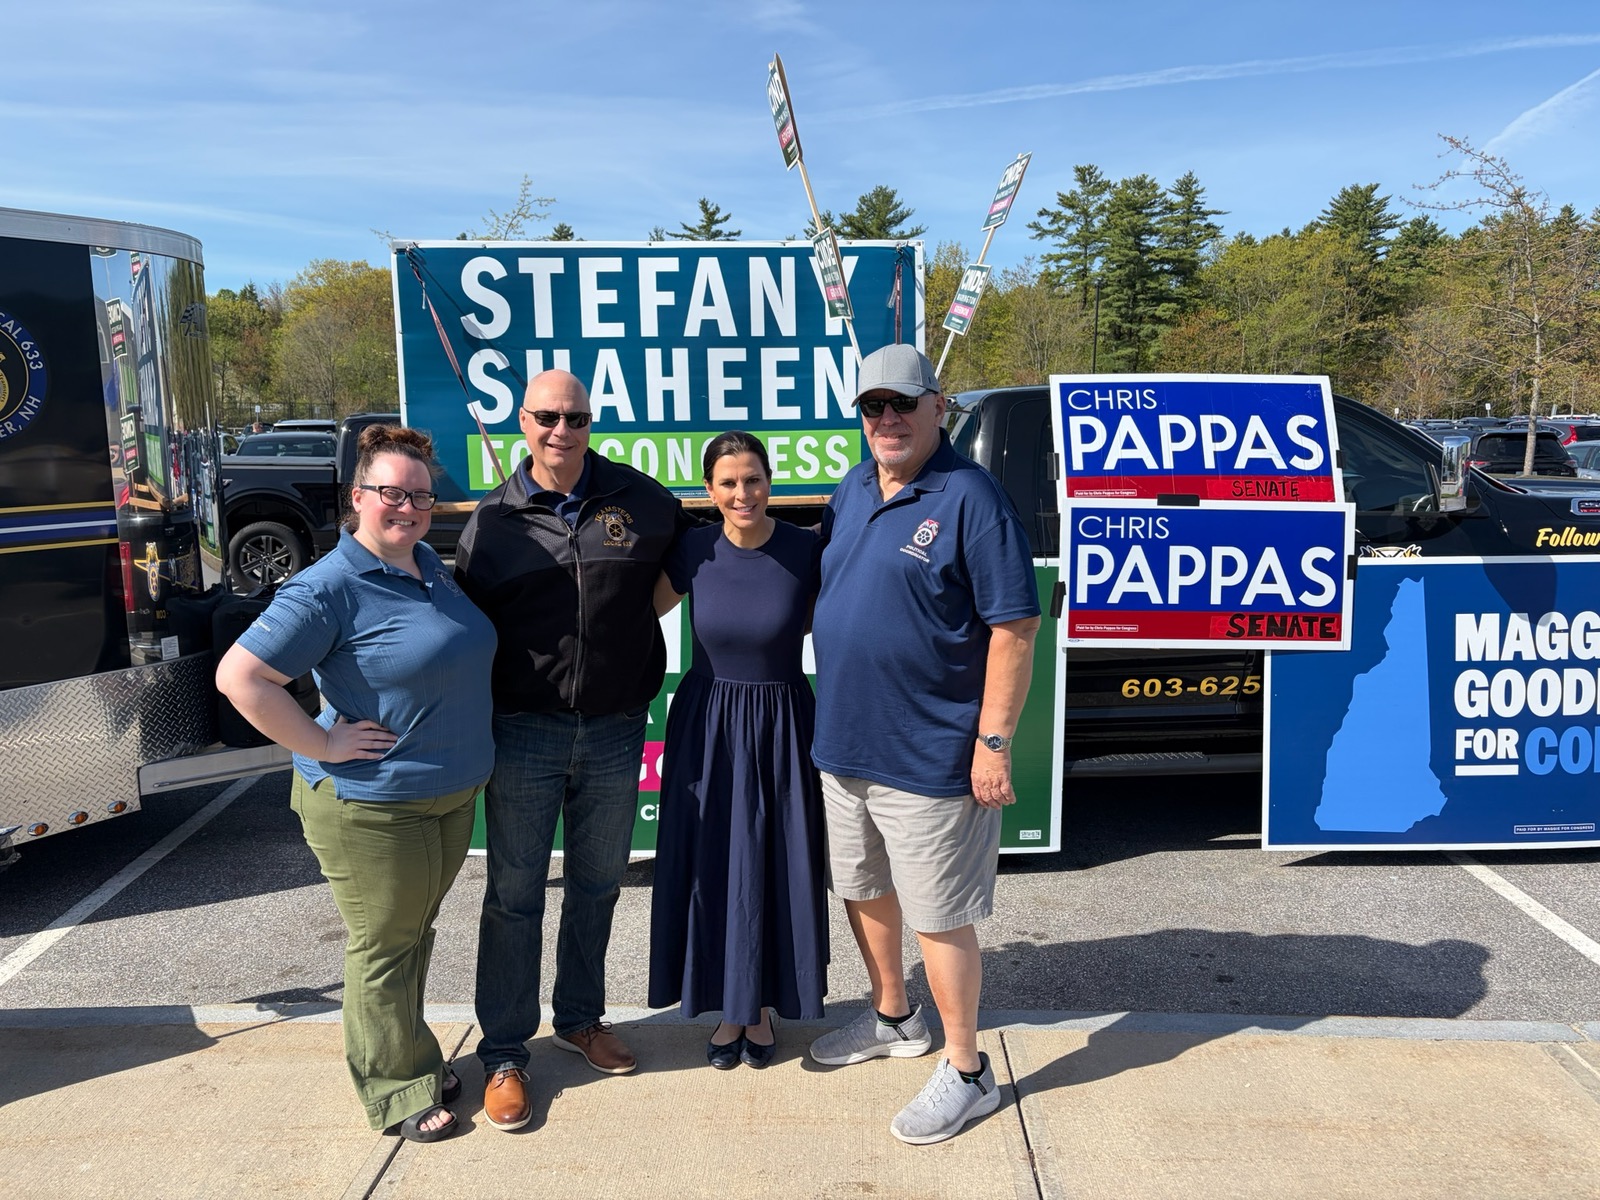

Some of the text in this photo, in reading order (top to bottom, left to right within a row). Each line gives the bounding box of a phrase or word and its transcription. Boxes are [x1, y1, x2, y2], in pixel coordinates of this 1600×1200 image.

[460, 256, 859, 340] STEFANY
[21, 341, 43, 370] 633
[18, 395, 41, 420] NH
[1068, 388, 1157, 410] CHRIS
[1068, 414, 1324, 471] PAPPAS
[481, 435, 850, 484] FO CONESS
[1232, 480, 1300, 500] SENATE
[594, 505, 634, 524] TEAMSTERS
[1078, 515, 1169, 539] CHRIS
[1536, 526, 1600, 547] Follow
[1076, 544, 1336, 607] PAPPAS
[1225, 613, 1337, 638] SENATE
[1455, 611, 1600, 661] MAGG
[1121, 675, 1261, 698] 603-625
[1454, 668, 1600, 719] GOOD
[1455, 726, 1600, 776] FOR CO
